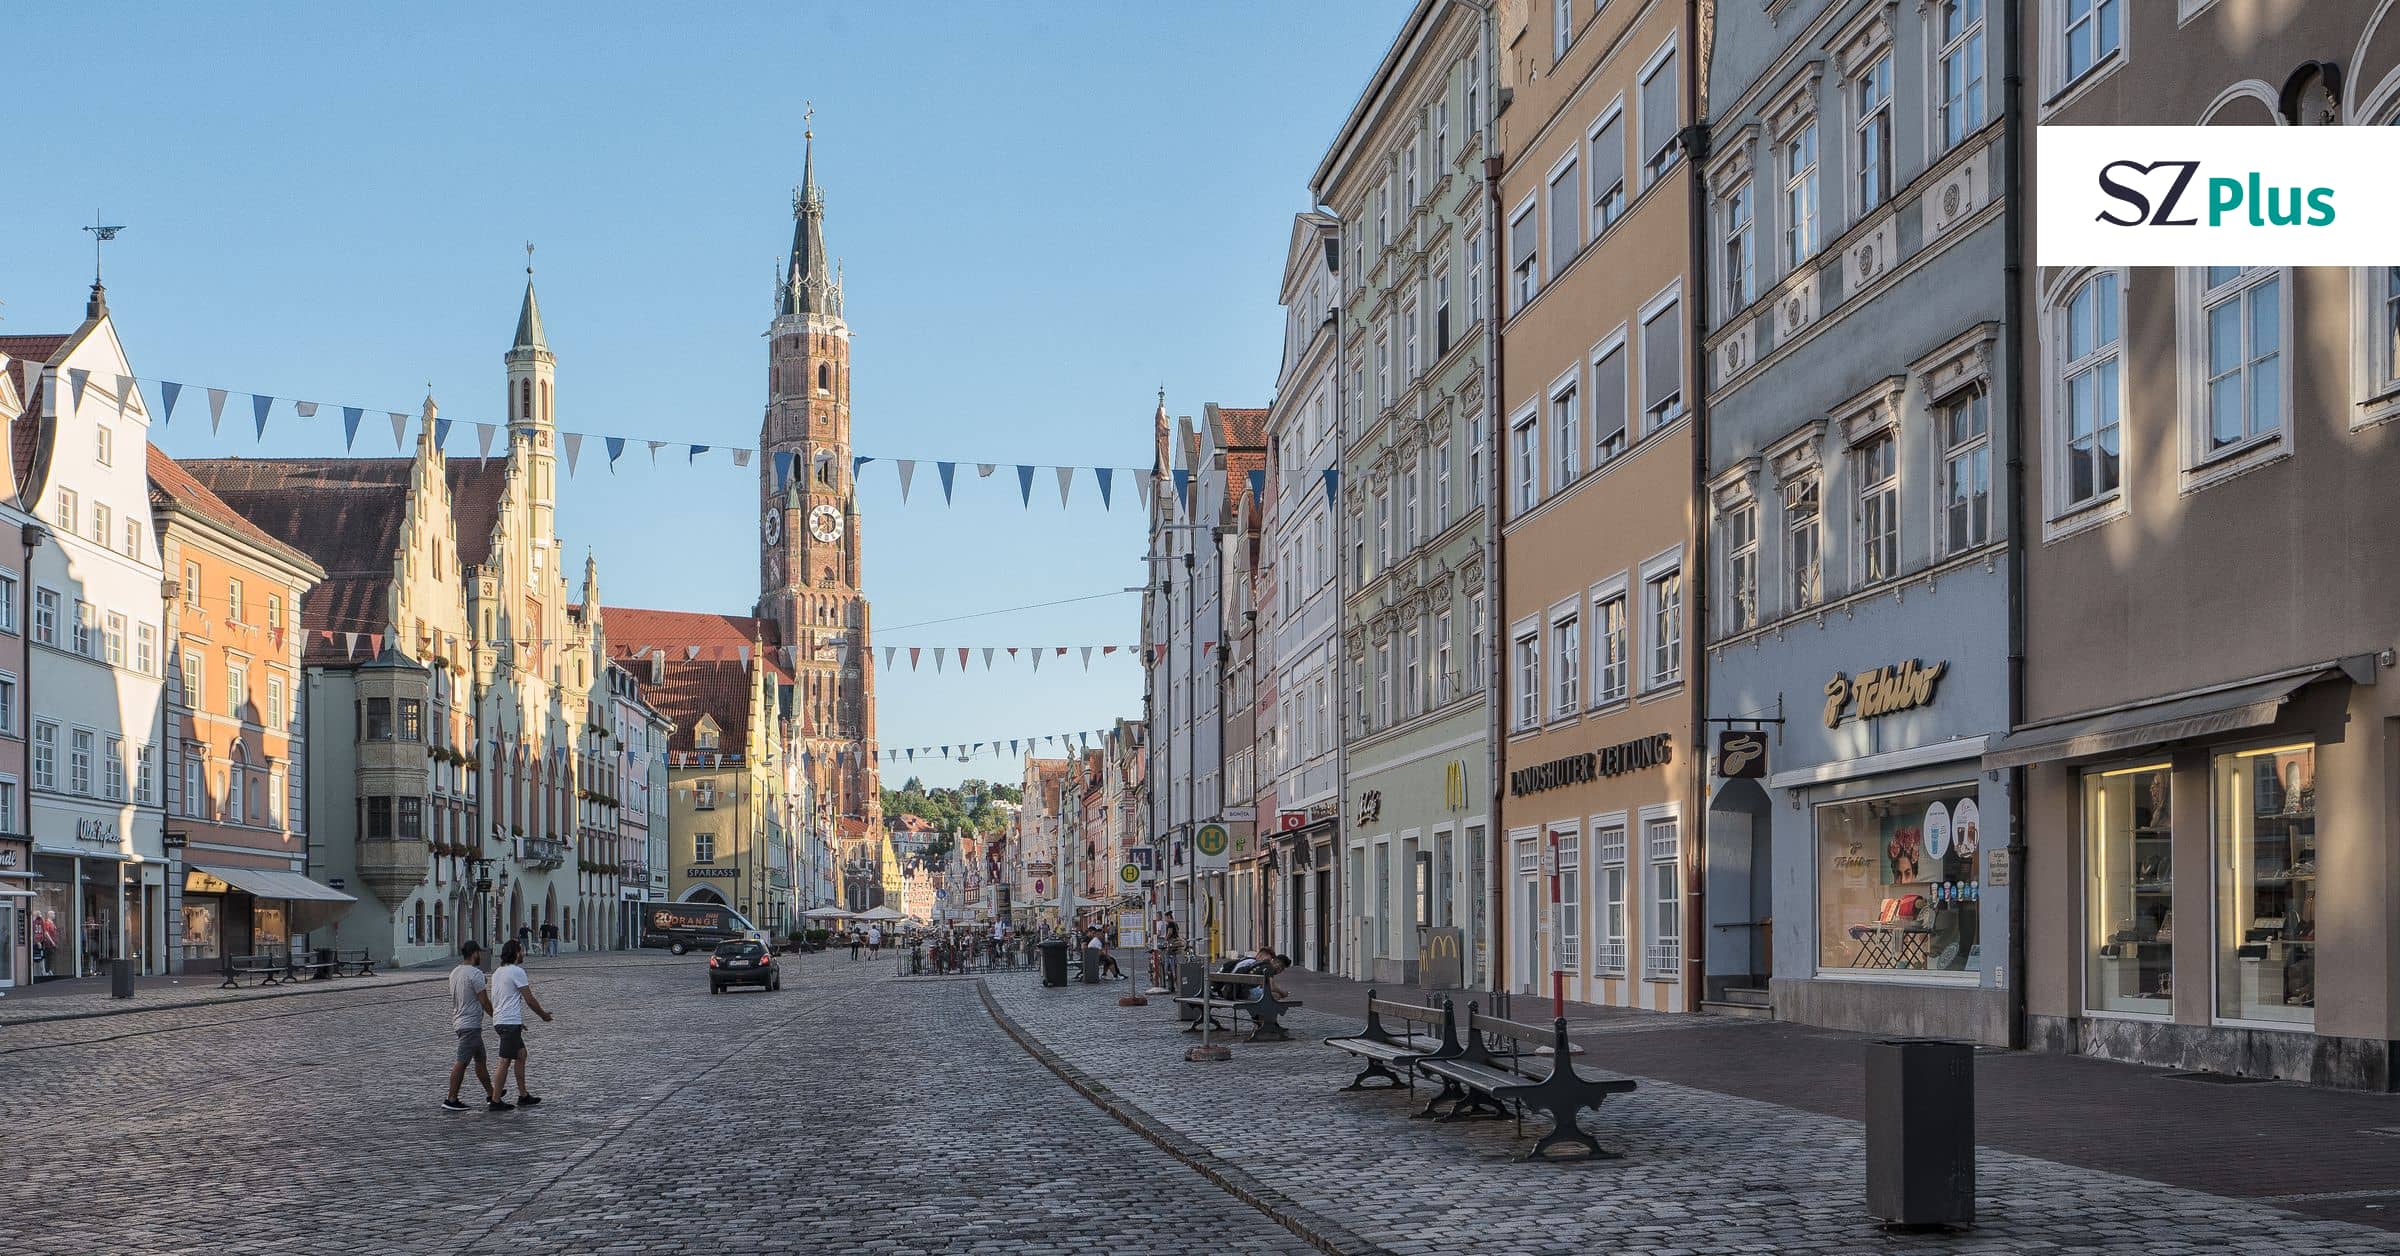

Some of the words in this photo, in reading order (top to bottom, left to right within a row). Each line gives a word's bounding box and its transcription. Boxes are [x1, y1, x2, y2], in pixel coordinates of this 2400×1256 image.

[1852, 658, 1946, 719] Tchibo
[1510, 753, 1595, 797] LANDSHUTER
[1597, 734, 1670, 777] ZEITUNG
[688, 869, 737, 877] SPARKASS
[671, 915, 719, 926] ORANGE
